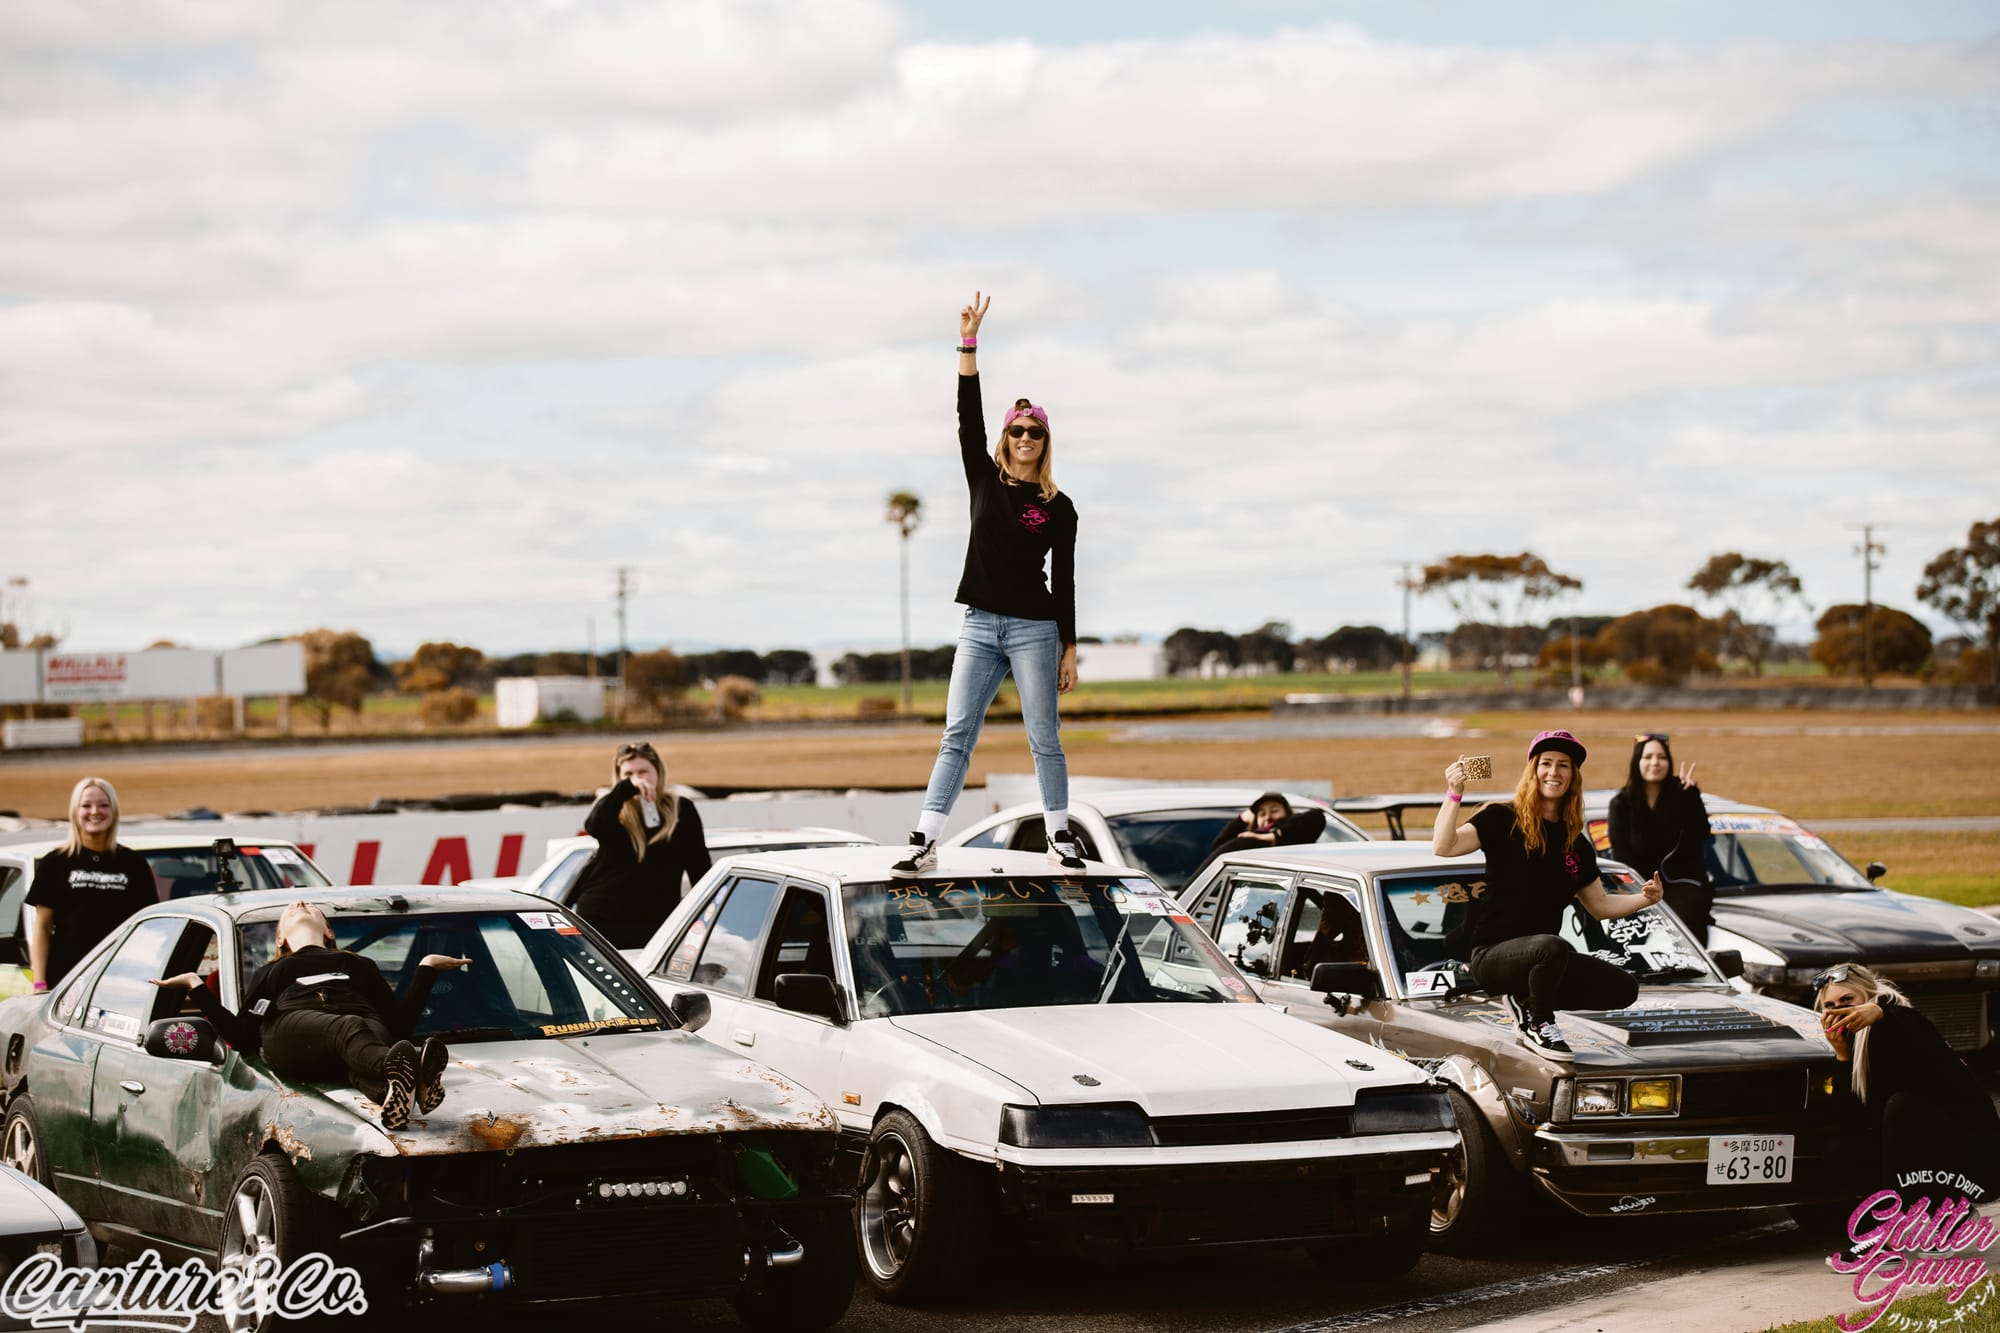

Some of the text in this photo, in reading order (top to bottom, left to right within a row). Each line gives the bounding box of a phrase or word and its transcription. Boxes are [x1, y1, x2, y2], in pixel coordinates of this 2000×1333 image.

[1430, 973, 1453, 991] A
[539, 1016, 659, 1037] RUNNING FREE
[1727, 1155, 1787, 1180] 63-80
